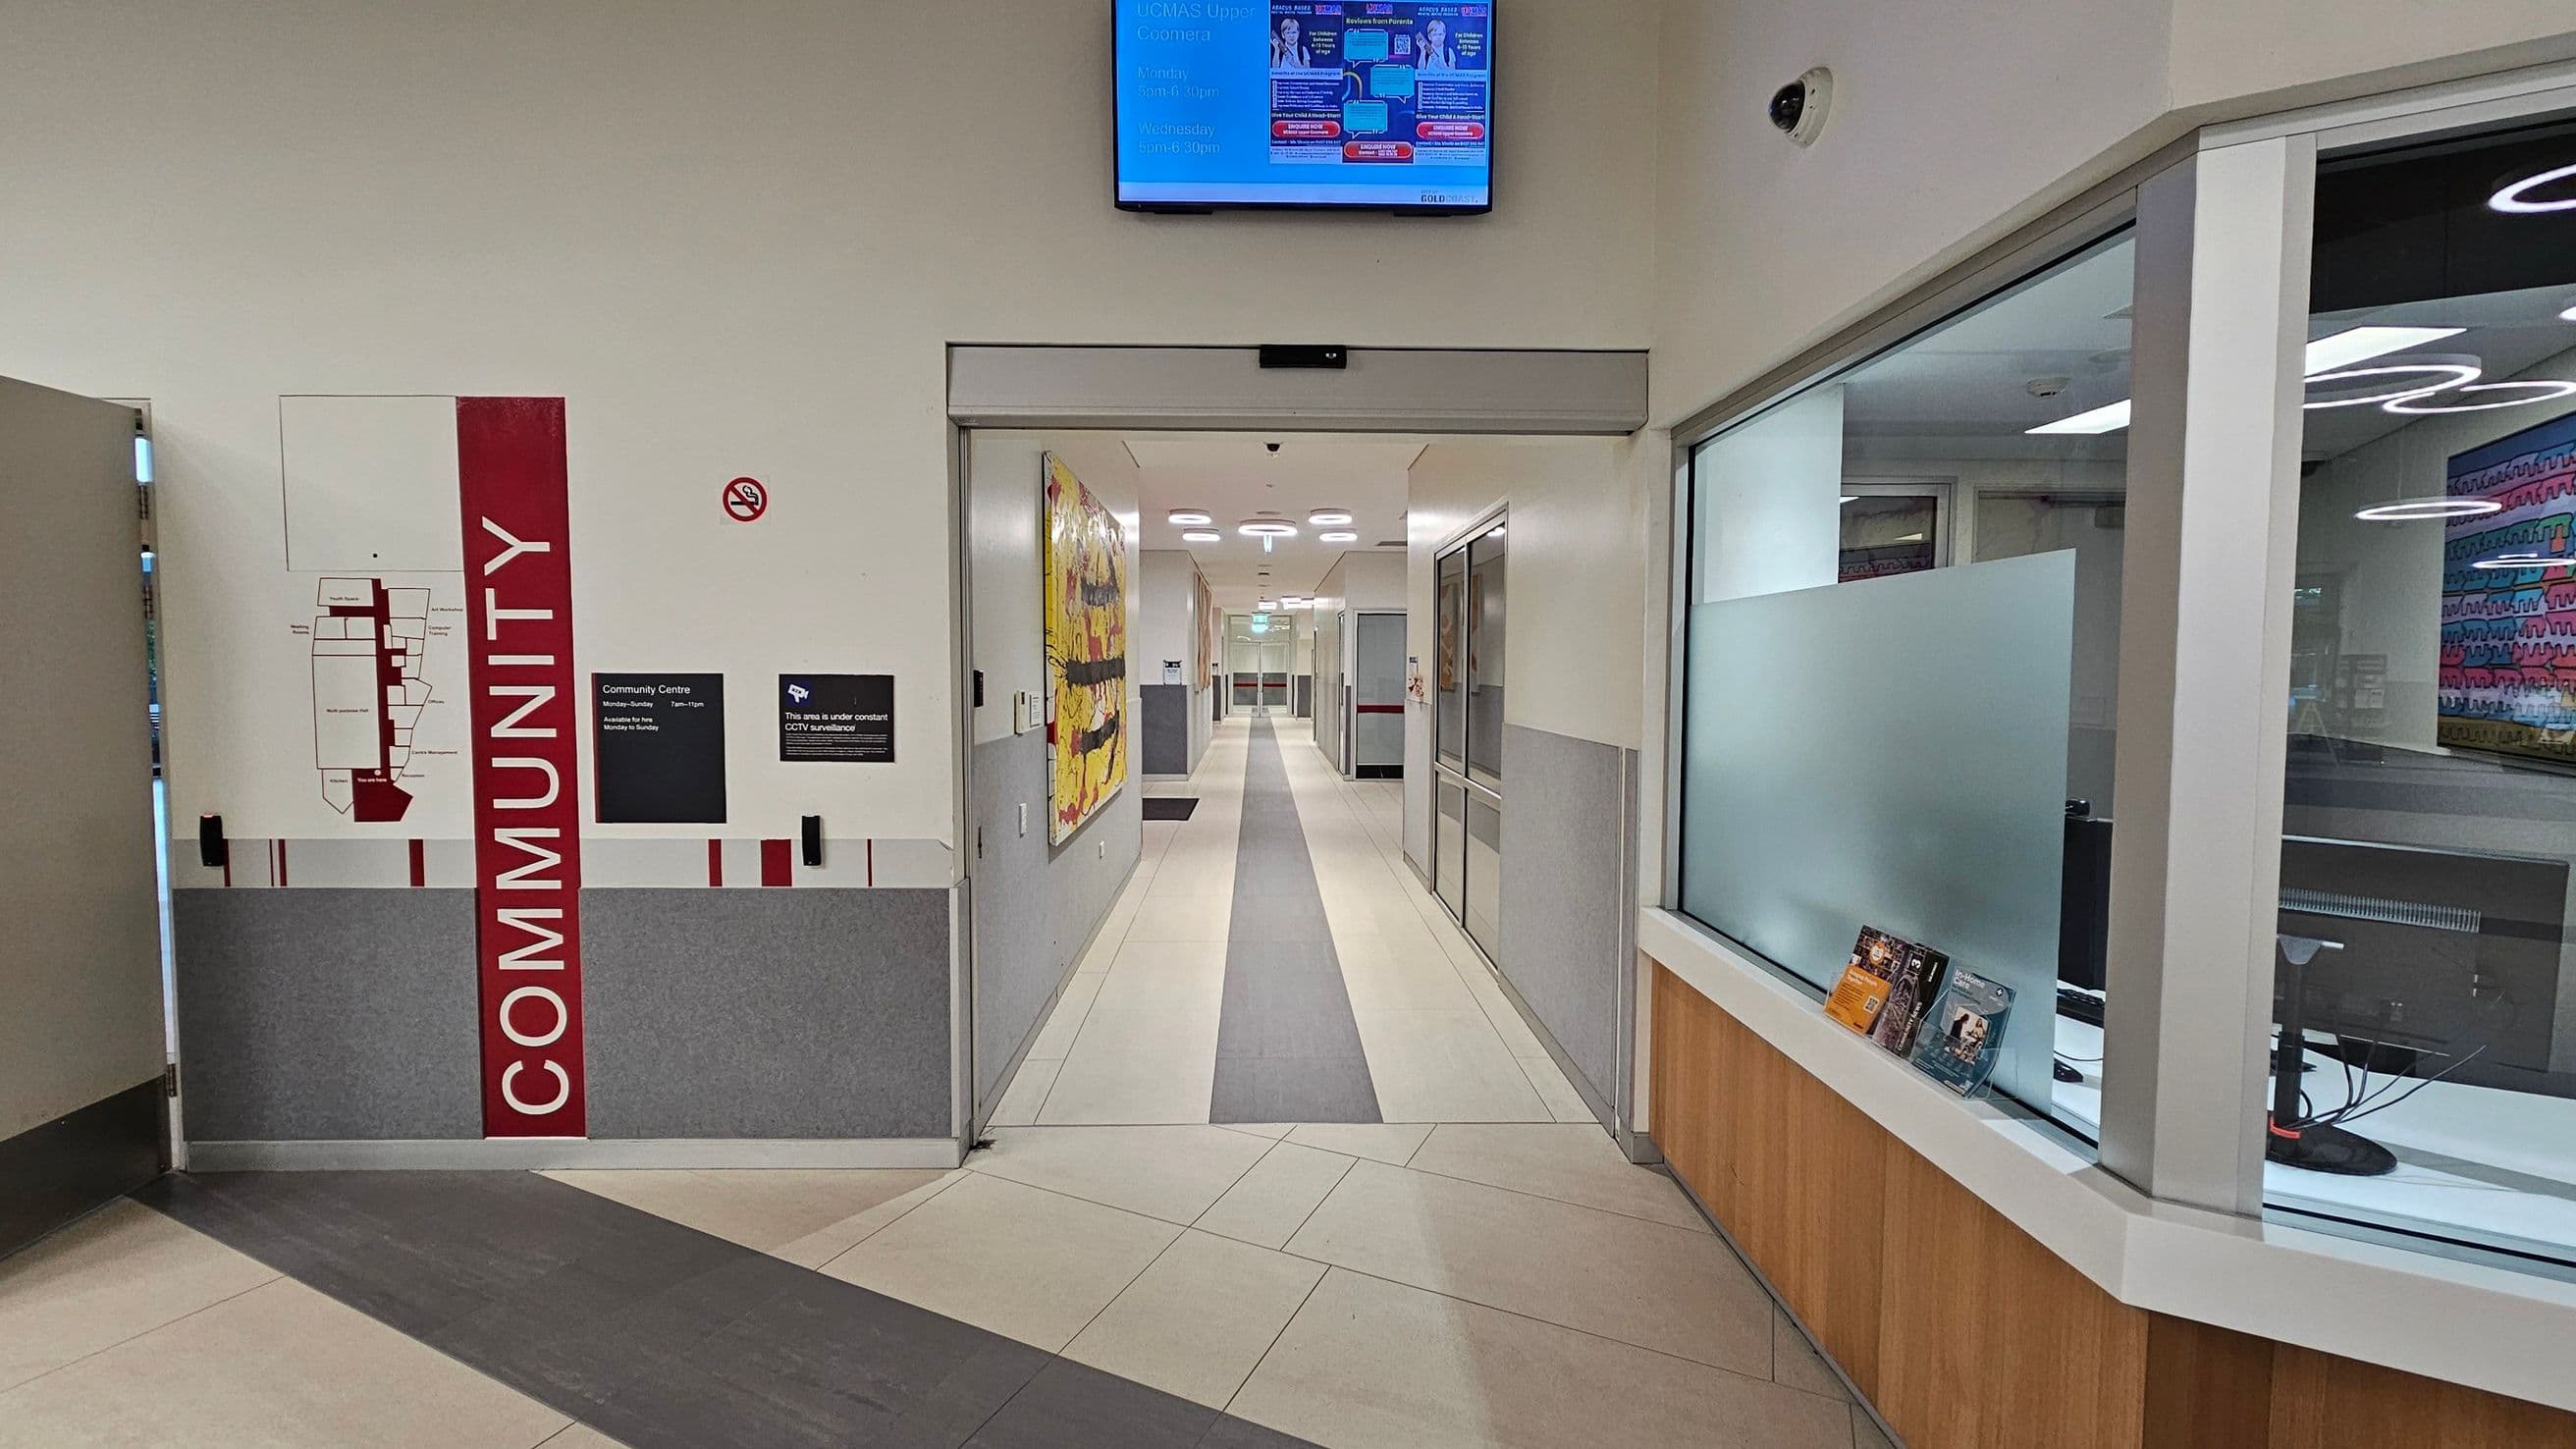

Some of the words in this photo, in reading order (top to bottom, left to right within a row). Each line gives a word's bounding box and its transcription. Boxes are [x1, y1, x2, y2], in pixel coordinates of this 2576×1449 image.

[1137, 3, 1201, 18] UCMAS
[1208, 3, 1257, 21] Upper
[1137, 26, 1210, 40] Coomera
[1138, 66, 1189, 80] Monday
[1138, 122, 1215, 137] Wednesday
[603, 684, 656, 696] Community
[658, 684, 691, 694] Centre
[785, 712, 801, 721] This
[784, 723, 809, 731] CCTV
[810, 724, 856, 732] surveillance
[481, 515, 569, 1115] COMMUNITY
[1911, 958, 1921, 969] 3
[1954, 977, 1970, 990] Care
[1955, 969, 1986, 989] In-Home
